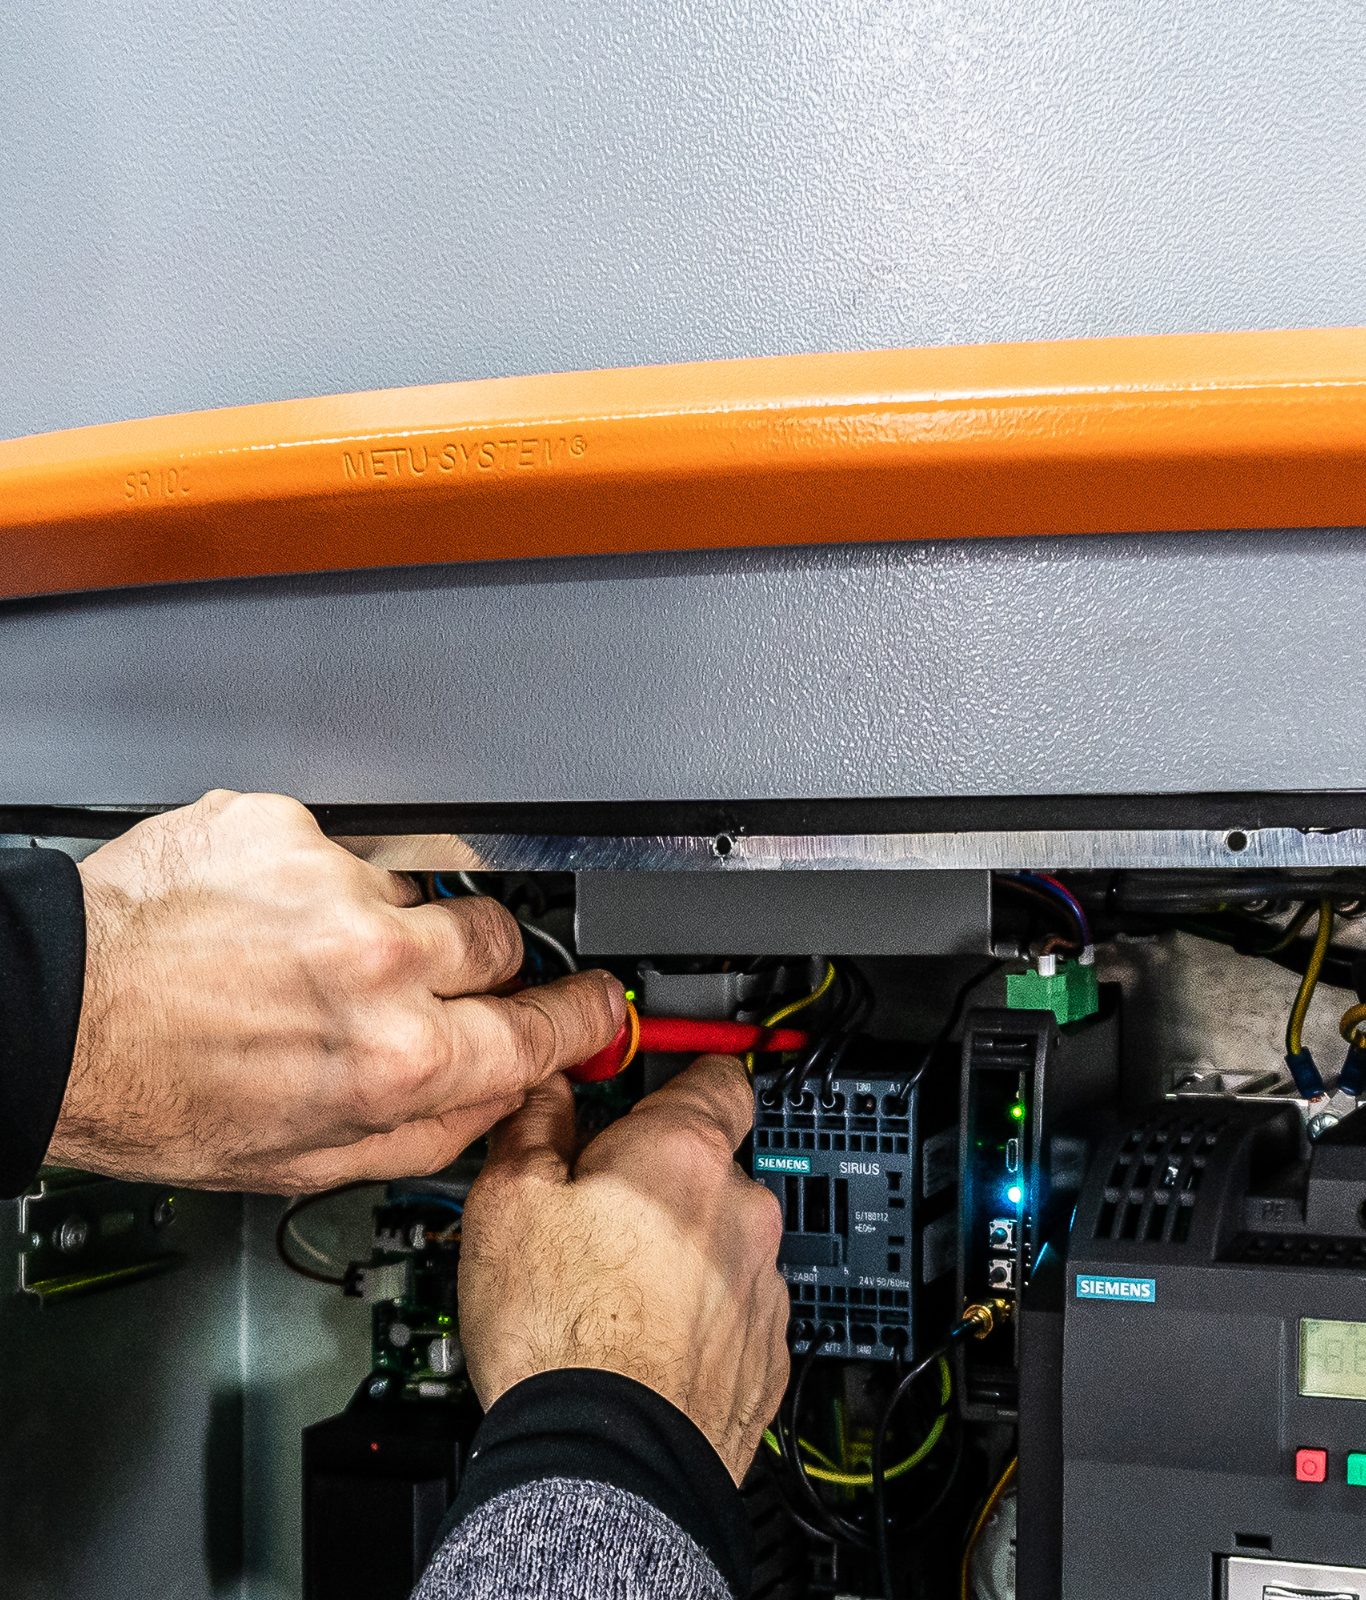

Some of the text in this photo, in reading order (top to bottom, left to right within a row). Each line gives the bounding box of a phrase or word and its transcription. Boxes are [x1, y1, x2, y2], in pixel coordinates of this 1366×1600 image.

[757, 1156, 810, 1171] SIEMENS
[839, 1161, 881, 1176] SIRIUS
[1080, 1279, 1151, 1298] SIEMENS
